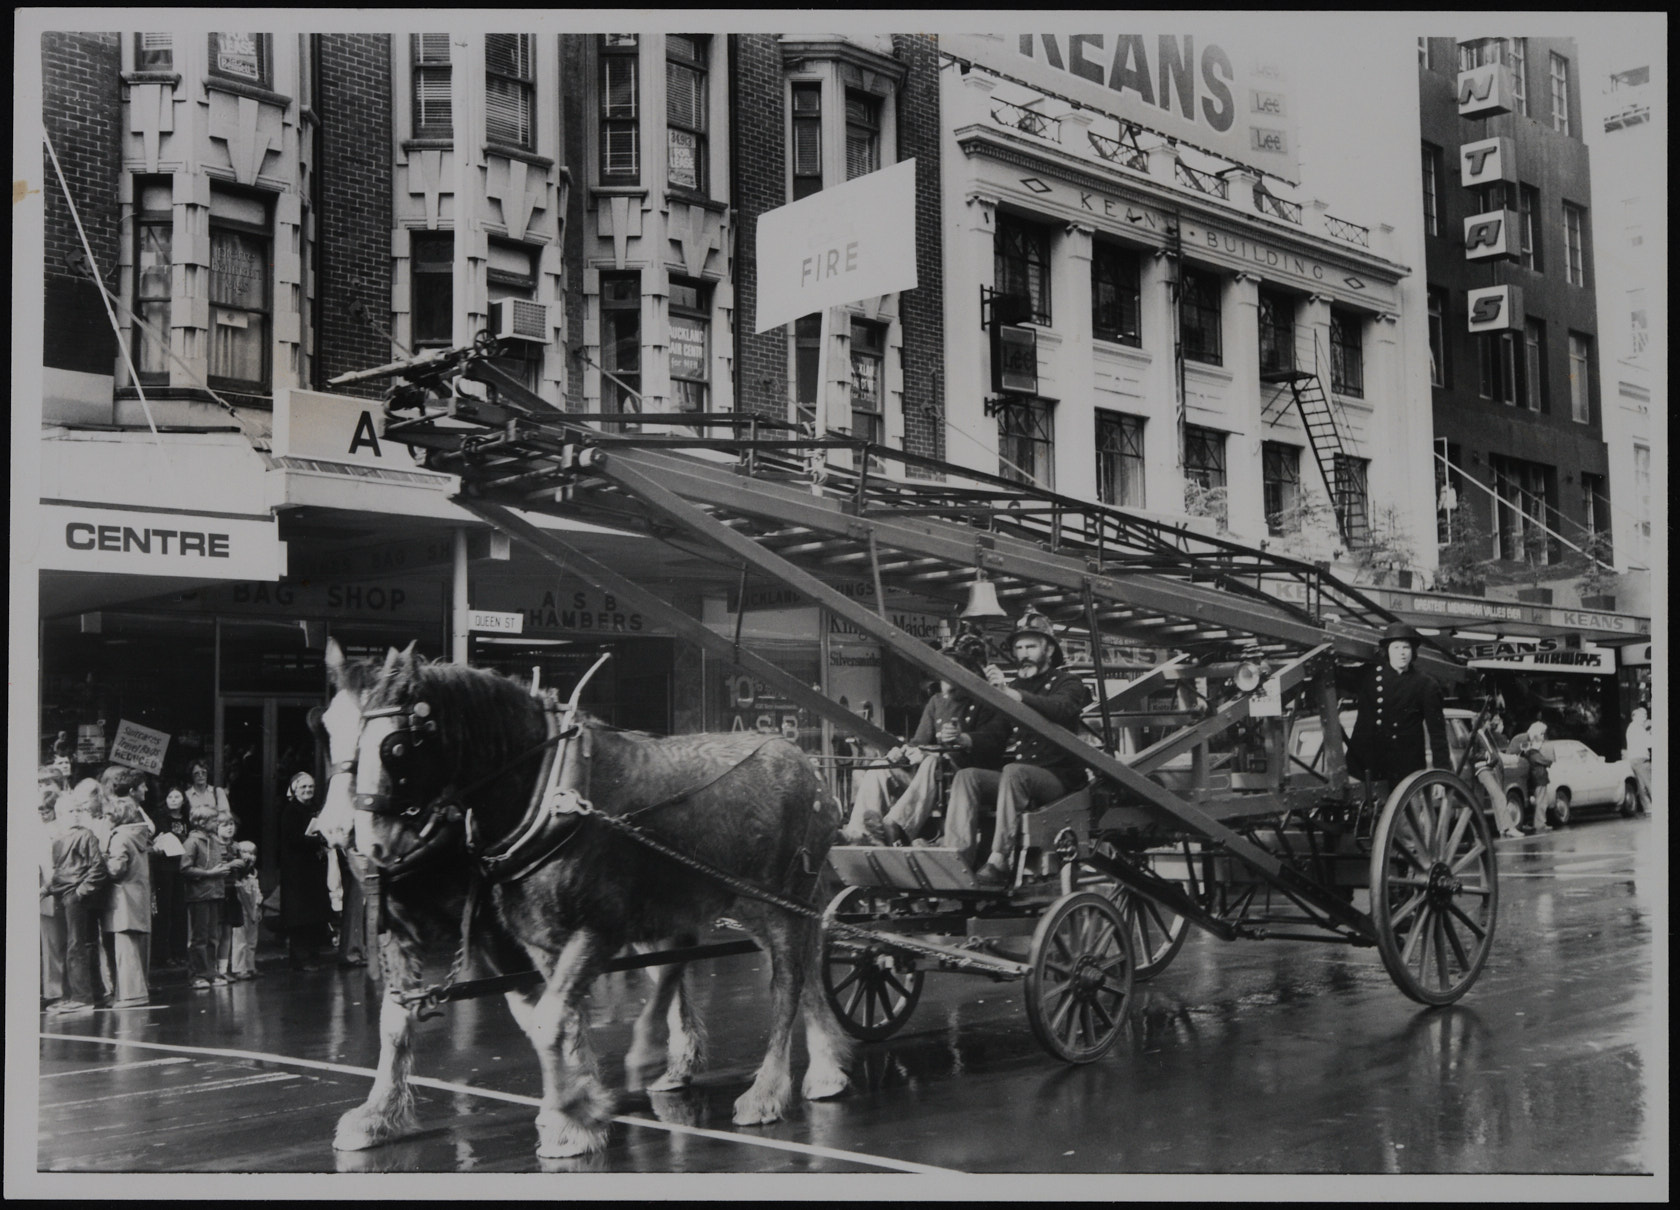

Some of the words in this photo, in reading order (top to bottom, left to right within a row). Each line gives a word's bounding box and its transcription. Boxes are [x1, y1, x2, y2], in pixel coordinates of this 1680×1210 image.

[220, 39, 255, 54] LEASE
[1256, 92, 1280, 113] Lee
[1256, 129, 1281, 150] Lee
[670, 157, 694, 168] LEASE
[673, 148, 690, 158] FOR
[800, 241, 860, 288] FIRE
[1207, 231, 1324, 280] BUILDING
[669, 341, 682, 355] AIR
[683, 344, 702, 357] CENTR
[1002, 345, 1033, 371] Lee
[349, 411, 382, 457] A
[66, 522, 230, 558] CENTRE
[427, 538, 477, 562] SHP
[233, 582, 294, 606] BAG
[328, 585, 406, 611] SHOP
[514, 608, 642, 631] HAMBERS
[1413, 598, 1447, 613] GREATEST
[1483, 605, 1506, 618] VALUES
[1506, 608, 1522, 620] EVER
[475, 615, 501, 628] QUEEN
[505, 617, 515, 629] ST
[1564, 613, 1624, 630] KEANS
[1455, 638, 1557, 659] KEANS
[829, 652, 881, 667] Silversmiths
[1534, 652, 1602, 667] AIRWAYS
[725, 675, 754, 708] 10
[117, 737, 141, 753] Travel
[139, 743, 161, 757] Bags
[114, 748, 158, 769] REDUCED
